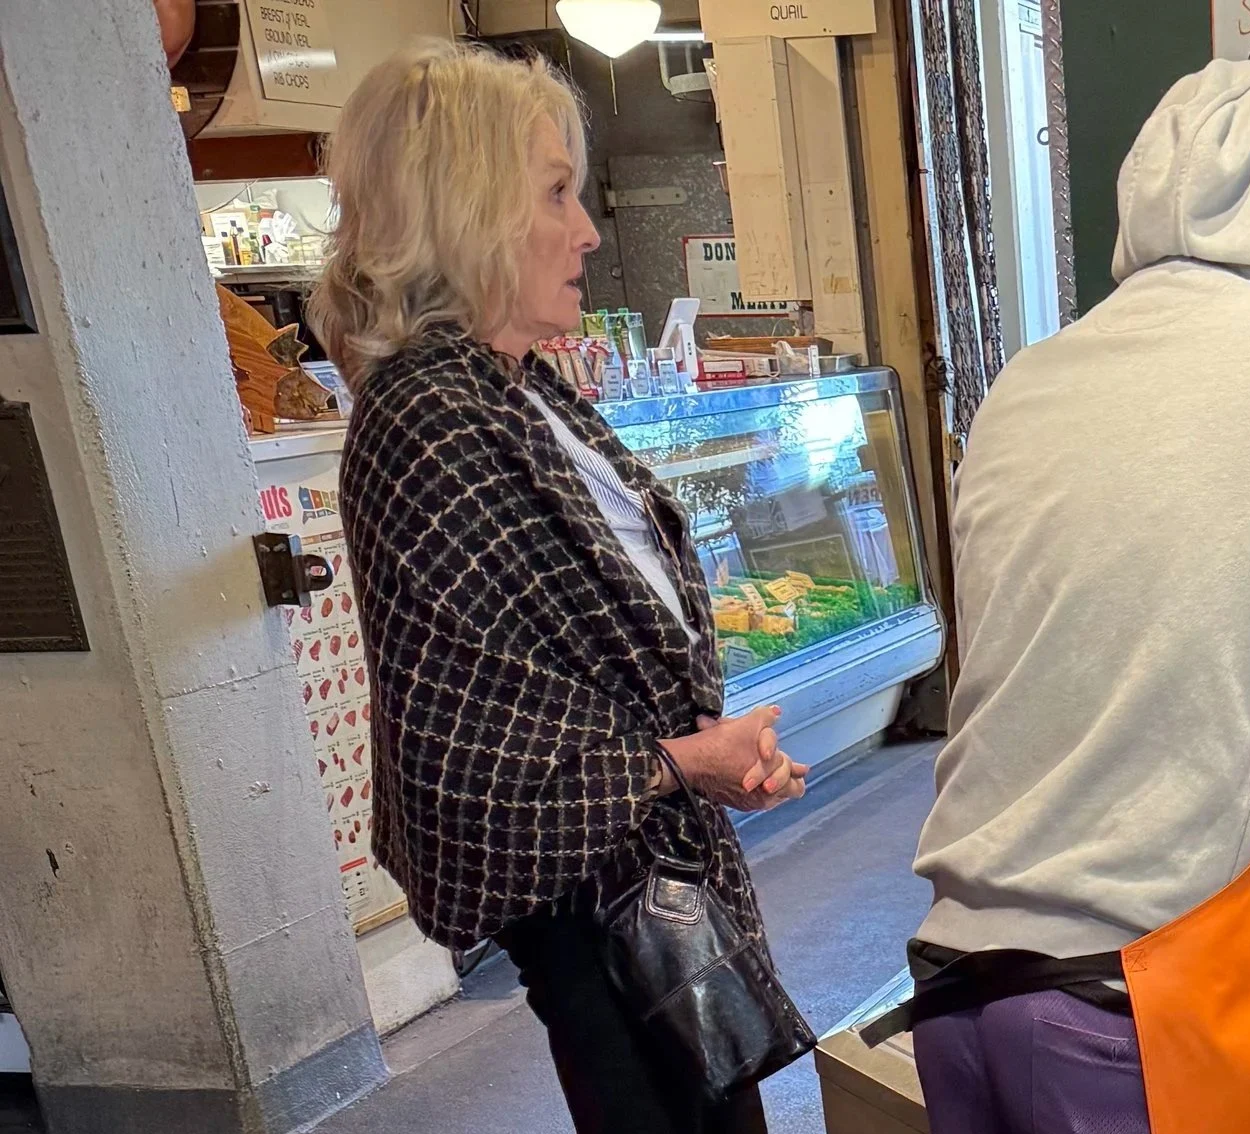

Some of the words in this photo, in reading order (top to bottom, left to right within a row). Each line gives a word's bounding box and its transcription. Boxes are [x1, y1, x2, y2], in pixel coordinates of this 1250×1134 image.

[770, 4, 808, 20] QUAIL
[293, 33, 311, 48] VEAL
[273, 71, 284, 86] RIB
[285, 72, 309, 89] CHOPS
[260, 485, 293, 520] uts
